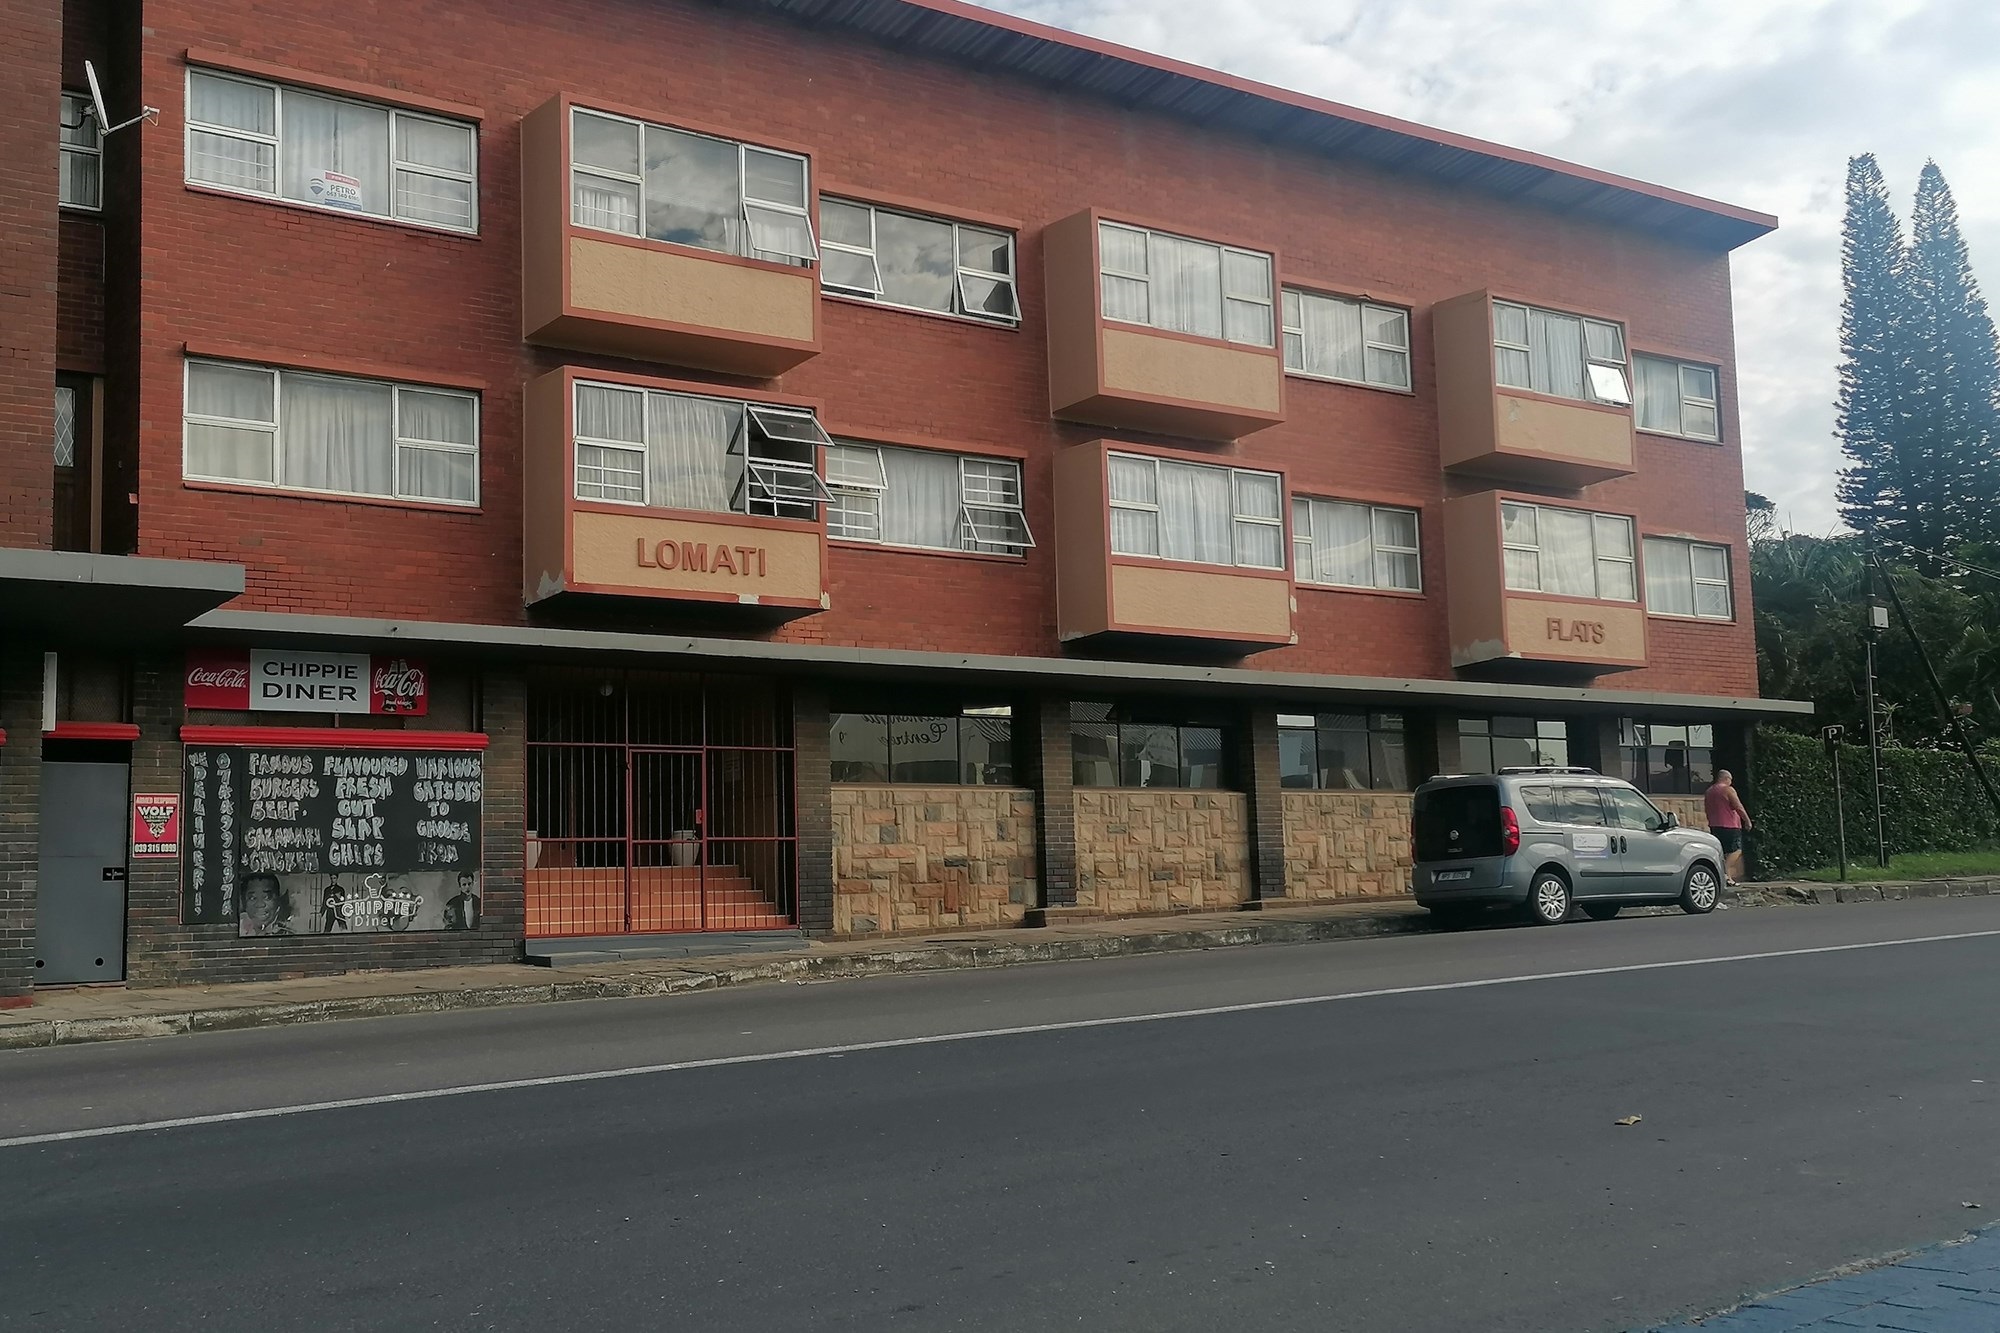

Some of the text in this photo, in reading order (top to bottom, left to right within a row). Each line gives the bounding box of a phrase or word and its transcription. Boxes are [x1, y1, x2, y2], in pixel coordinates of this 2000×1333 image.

[330, 184, 356, 195] PETRO
[637, 537, 766, 577] LOMATI
[1546, 617, 1606, 644] FLATS
[188, 667, 248, 688] Coca-Cola
[262, 661, 358, 680] CHIPPIE
[262, 682, 358, 702] DINER
[1828, 727, 1838, 739] P
[248, 752, 314, 776] FAMOUS
[322, 754, 408, 777] FLAVOURED
[249, 777, 320, 801] BURGERS
[334, 775, 394, 800] FRESH
[412, 780, 482, 803] GATSBYS
[138, 806, 174, 815] WOLF
[337, 798, 377, 819] CUT
[427, 800, 450, 818] TO
[415, 819, 472, 843] CHOOSE
[134, 843, 148, 853] 039
[328, 840, 386, 867] CHIPS
[416, 841, 460, 865] FROM
[341, 900, 411, 917] CHIPPIE
[354, 915, 396, 927] Diner
